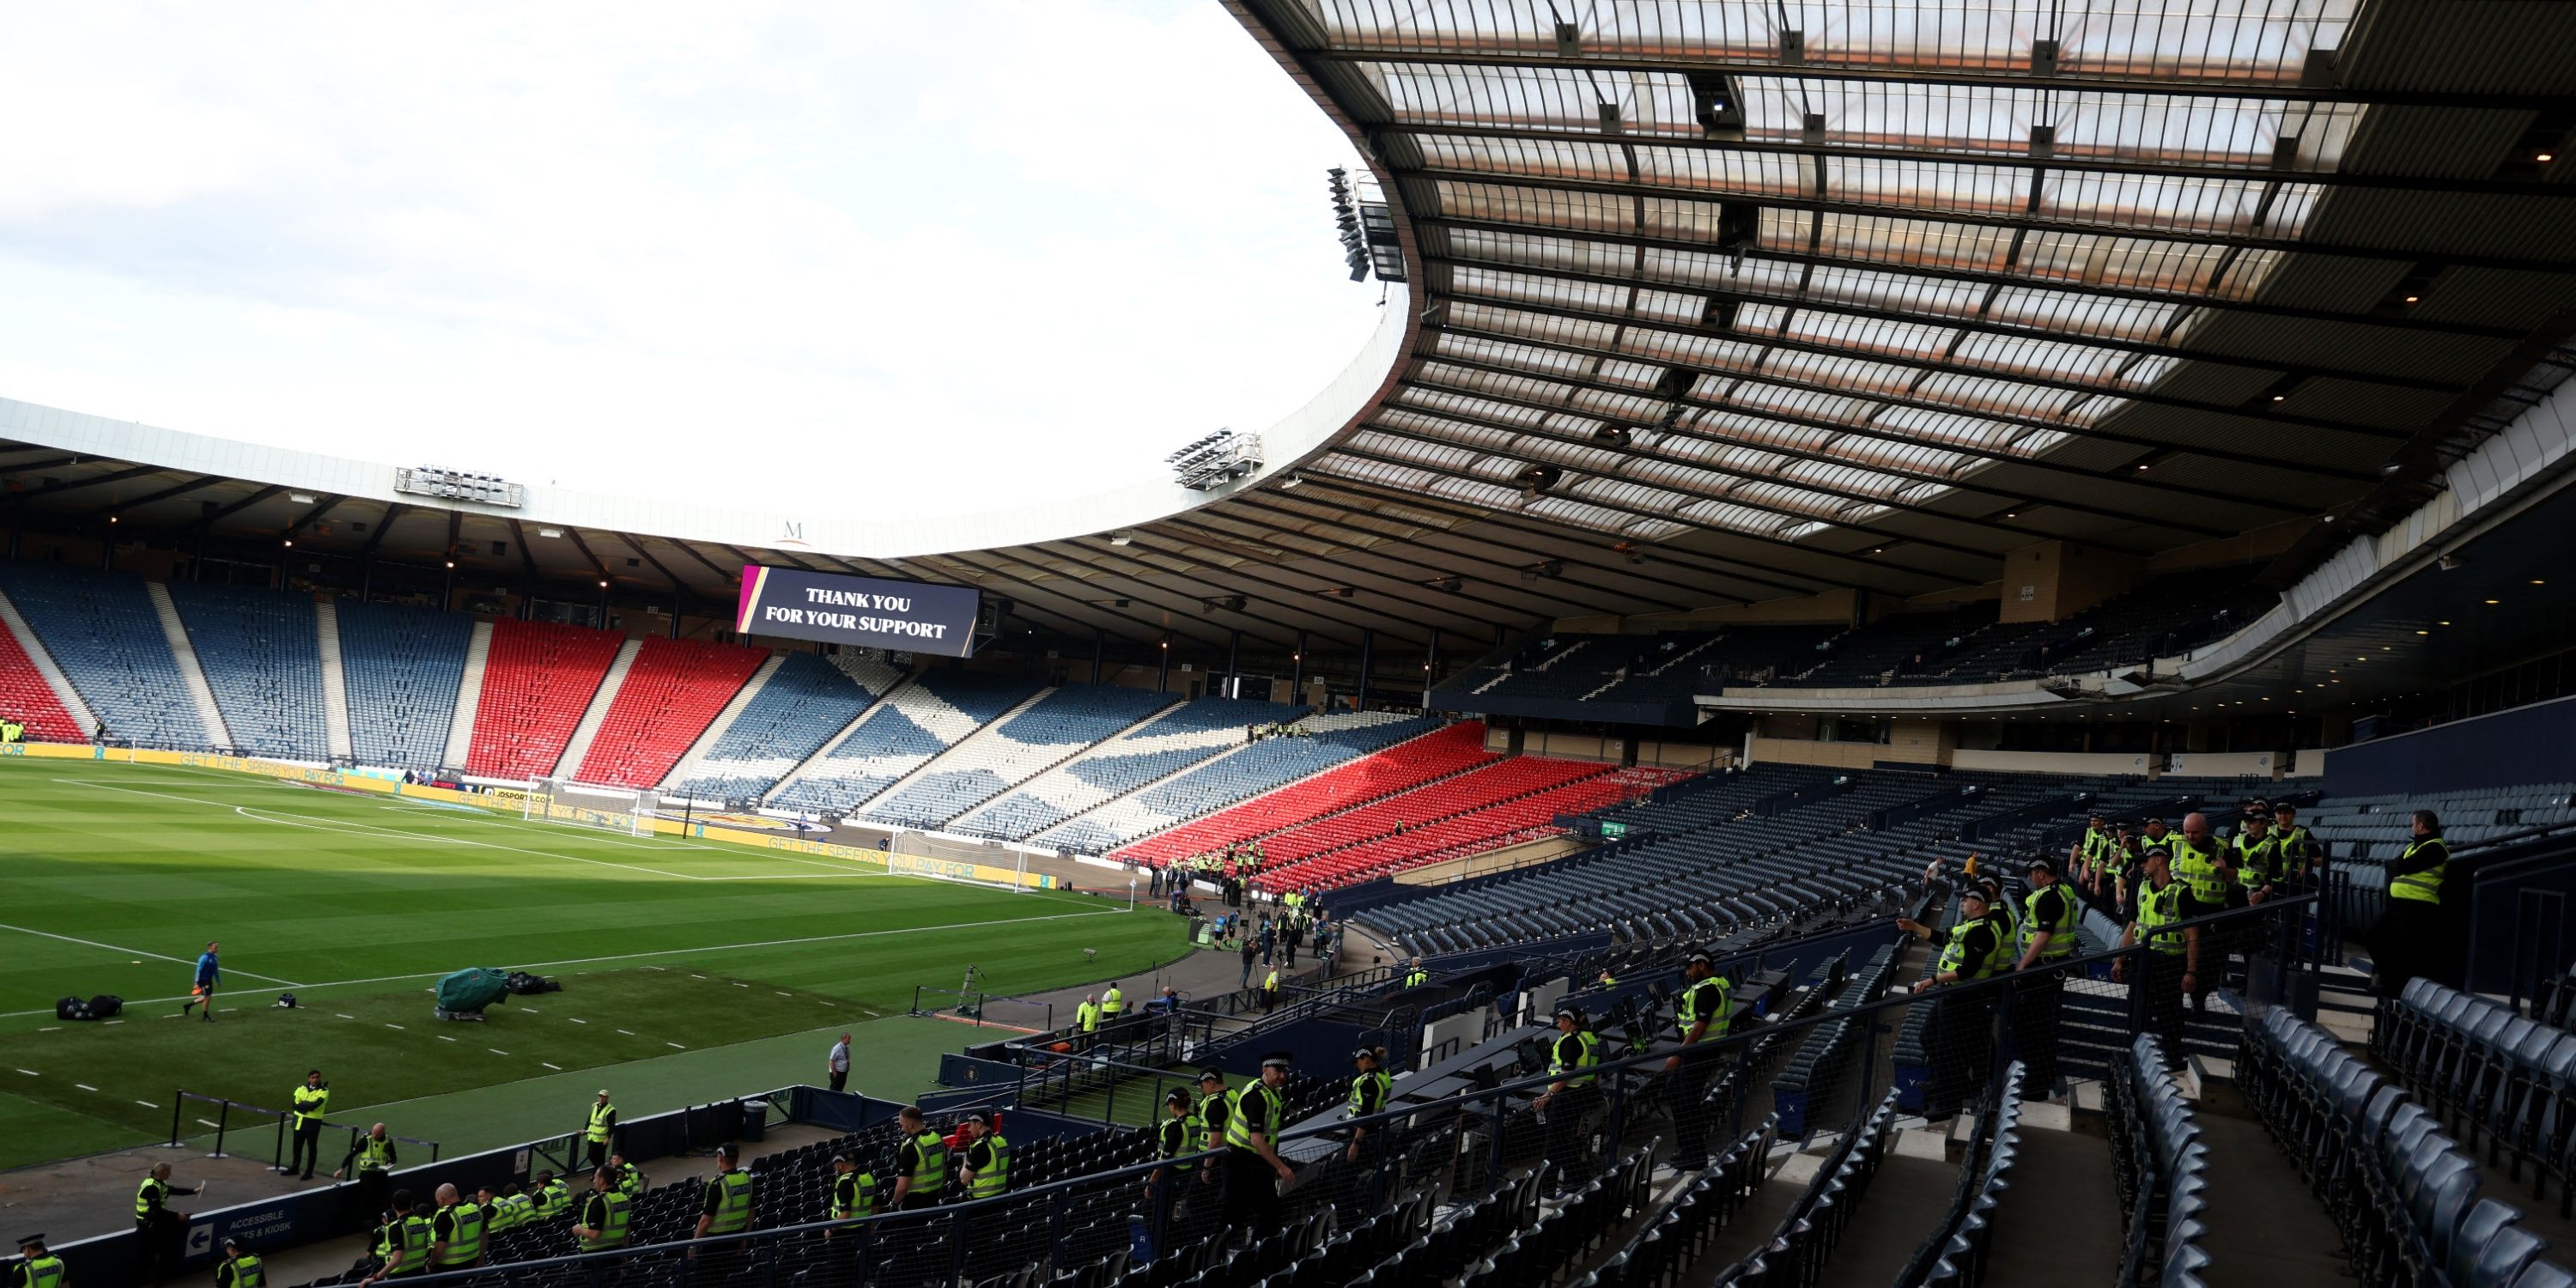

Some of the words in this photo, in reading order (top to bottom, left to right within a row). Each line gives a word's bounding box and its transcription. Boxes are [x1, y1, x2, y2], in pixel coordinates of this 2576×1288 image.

[784, 520, 803, 539] M
[806, 587, 869, 609] THANK
[872, 595, 911, 613] YOU
[766, 606, 803, 624] FOR
[806, 611, 857, 629] YOUR
[859, 617, 947, 640] SUPPORT
[180, 755, 209, 769] GET
[216, 757, 241, 771] THE
[246, 760, 282, 777] SPEEDS
[283, 766, 302, 781] YOU
[304, 769, 323, 782] PAY
[325, 773, 343, 785] FOR
[459, 792, 482, 805] GET
[484, 796, 507, 810] THE
[769, 836, 796, 852] GET
[800, 841, 825, 855] THE
[828, 846, 878, 865] SPEEDS
[915, 860, 944, 874] PAY
[945, 864, 975, 878] FOR
[1909, 1078, 1916, 1087] Y
[1788, 1103, 1795, 1113] X
[230, 1210, 284, 1230] ACCESSIBLE
[257, 1229, 264, 1237] &
[264, 1221, 291, 1236] KIOSK
